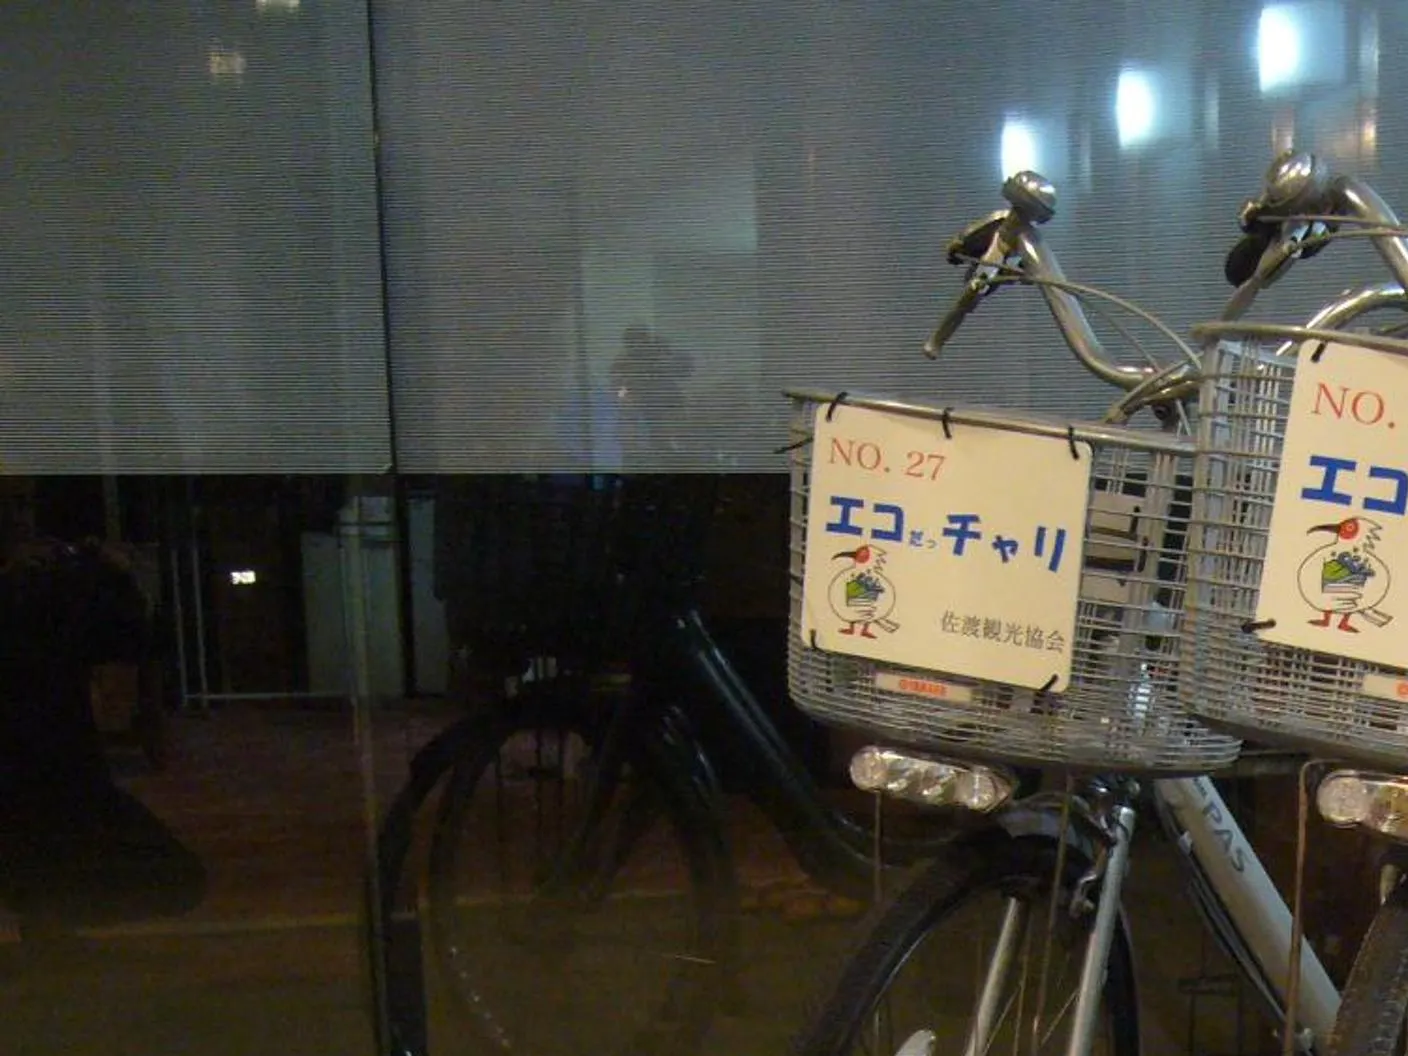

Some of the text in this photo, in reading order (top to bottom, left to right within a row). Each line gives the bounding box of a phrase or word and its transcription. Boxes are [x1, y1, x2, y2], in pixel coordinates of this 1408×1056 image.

[1311, 382, 1396, 429] NO.
[827, 437, 947, 481] NO. 27
[940, 610, 1066, 653] 佐渡観光協会
